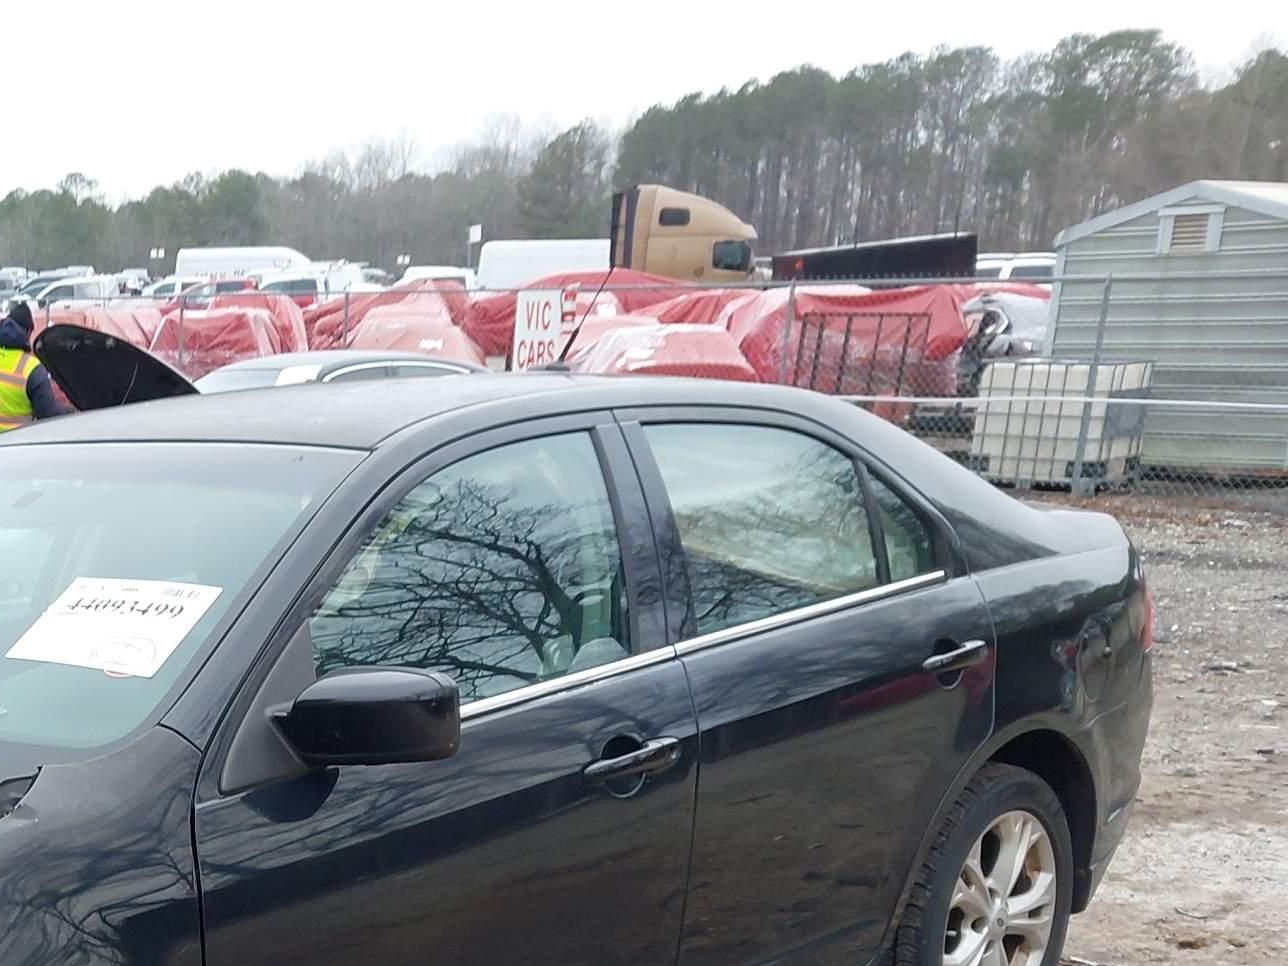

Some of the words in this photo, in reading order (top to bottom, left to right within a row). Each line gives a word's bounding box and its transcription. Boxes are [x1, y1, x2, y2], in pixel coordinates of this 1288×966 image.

[526, 300, 552, 330] VIC
[517, 340, 555, 369] CARS
[67, 597, 185, 618] 44093499
